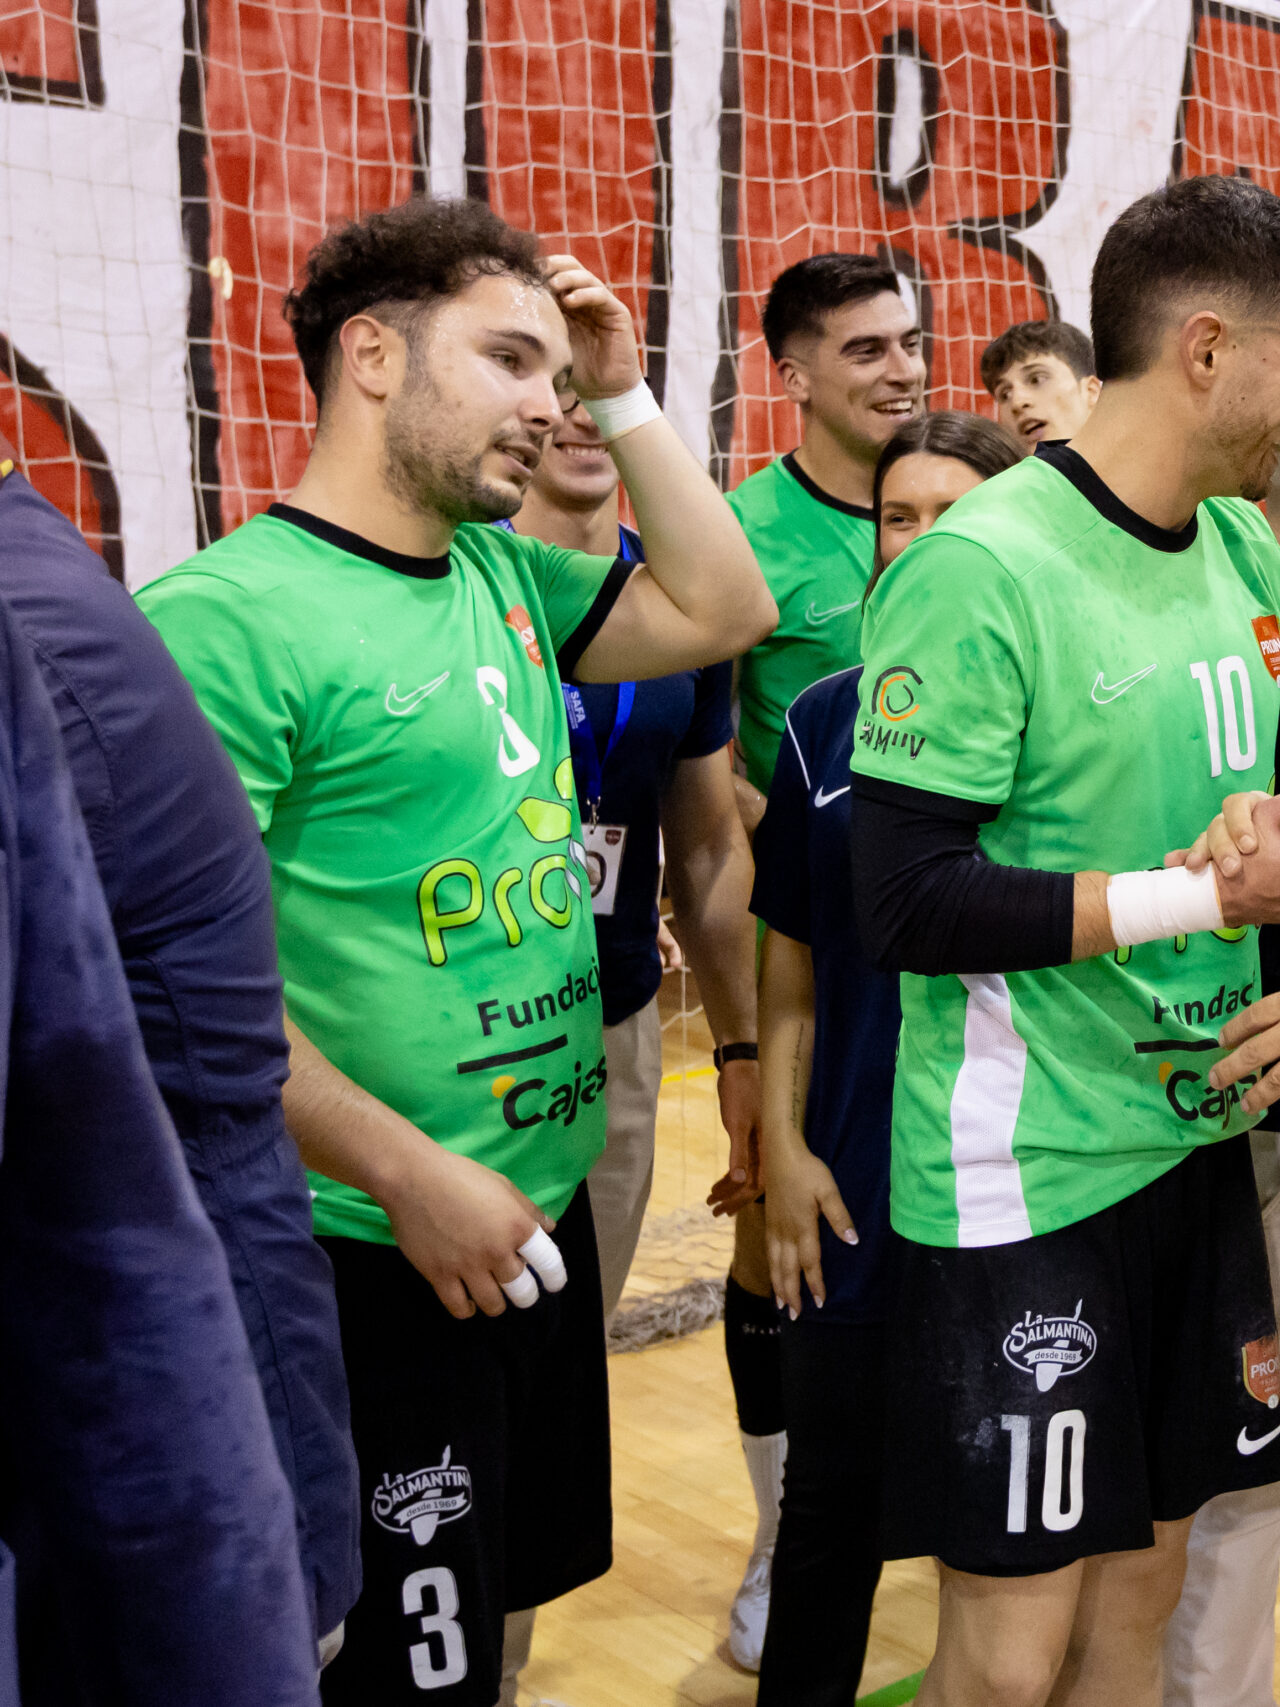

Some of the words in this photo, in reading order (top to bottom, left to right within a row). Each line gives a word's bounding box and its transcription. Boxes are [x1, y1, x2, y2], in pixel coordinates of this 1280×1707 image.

[570, 690, 587, 724] SAFA
[1189, 655, 1258, 779] 10
[1025, 1310, 1043, 1328] La
[1009, 1322, 1093, 1353] SALMANTINA
[1034, 1351, 1059, 1360] desde
[383, 1472, 405, 1489] La
[1001, 1409, 1087, 1533] 10
[406, 1502, 432, 1518] desde
[433, 1499, 457, 1510] 1969
[402, 1566, 468, 1690] 3
